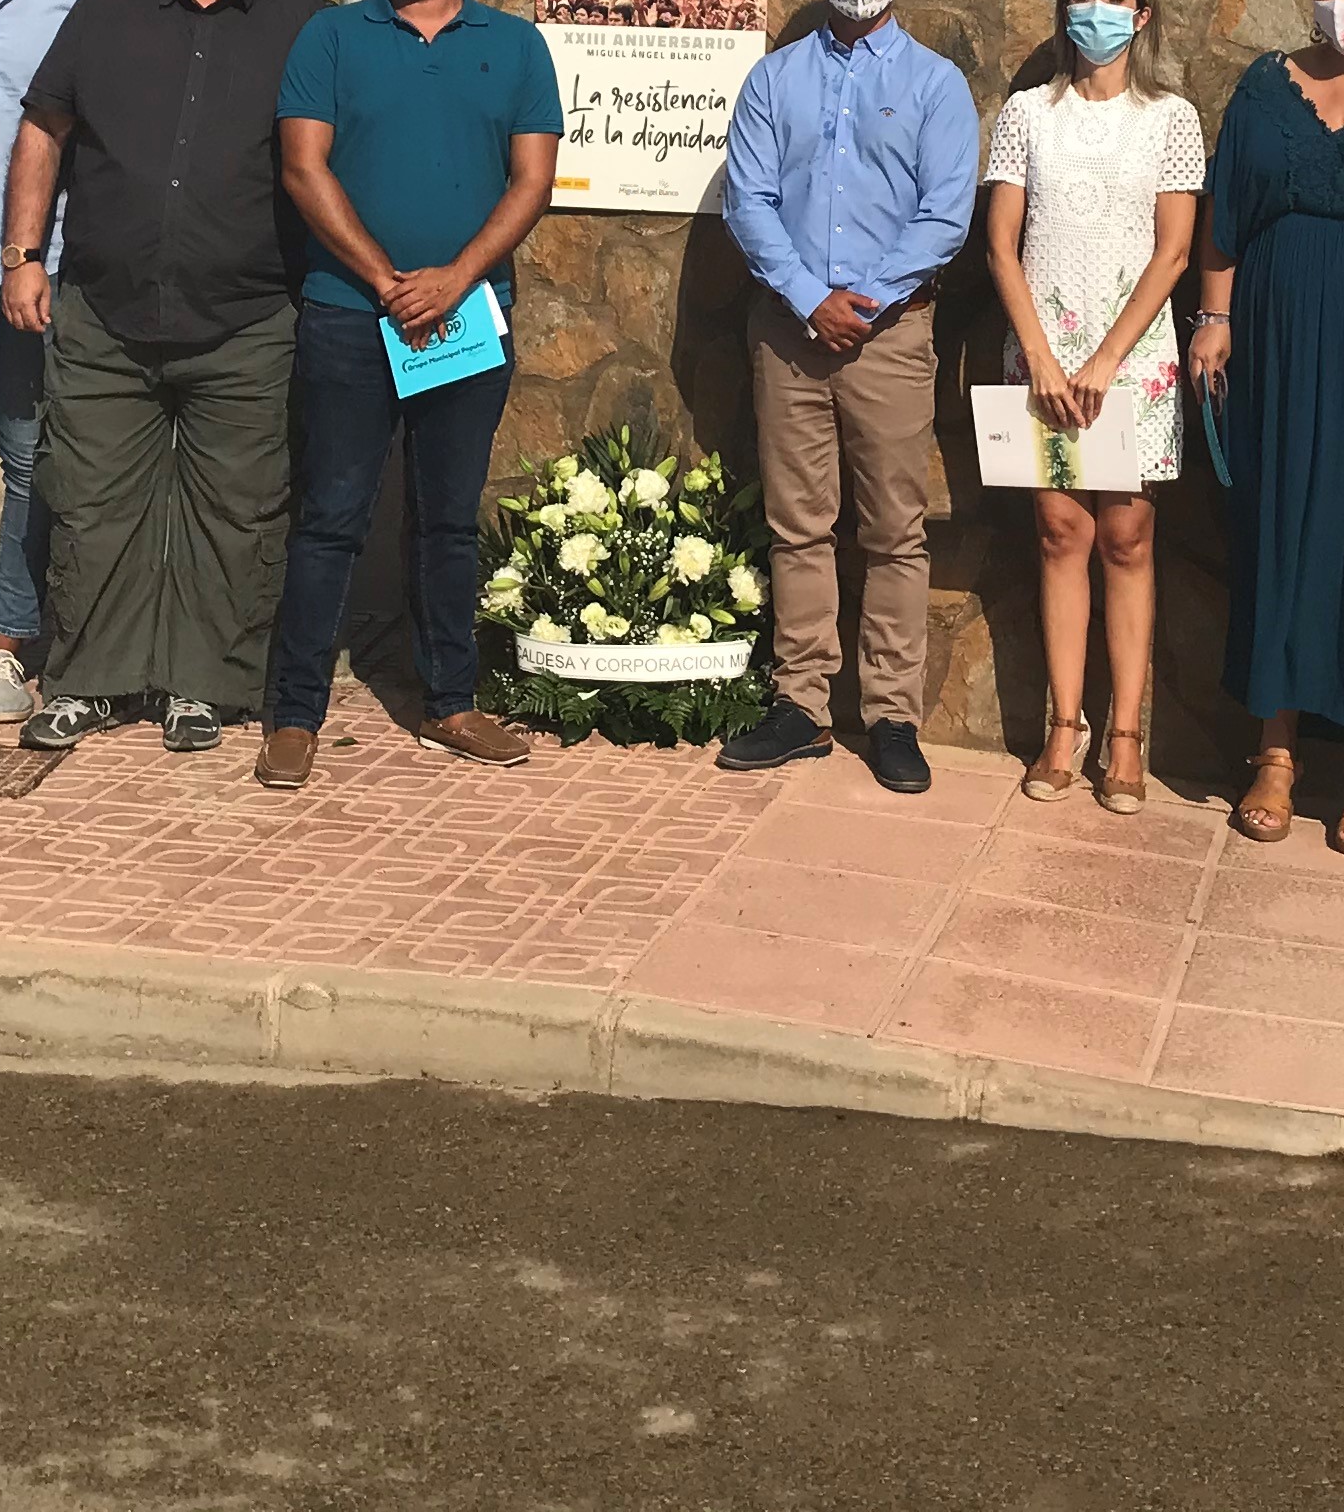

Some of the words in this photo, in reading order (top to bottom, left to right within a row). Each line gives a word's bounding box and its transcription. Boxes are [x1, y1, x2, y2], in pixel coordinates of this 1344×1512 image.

[563, 31, 606, 46] XXIII
[612, 32, 736, 51] ANIVERSARIO
[586, 48, 626, 58] MIGUEL
[631, 47, 665, 59] ÁNGEL
[670, 50, 712, 61] BLANCO
[568, 73, 602, 115] La
[612, 80, 727, 114] resistencia
[569, 114, 594, 148] de
[605, 114, 623, 145] la
[632, 117, 732, 162] dignidad
[429, 349, 461, 364] Municipal
[580, 656, 591, 671] Y
[595, 655, 725, 673] CORPORACION
[730, 652, 751, 668] MU
